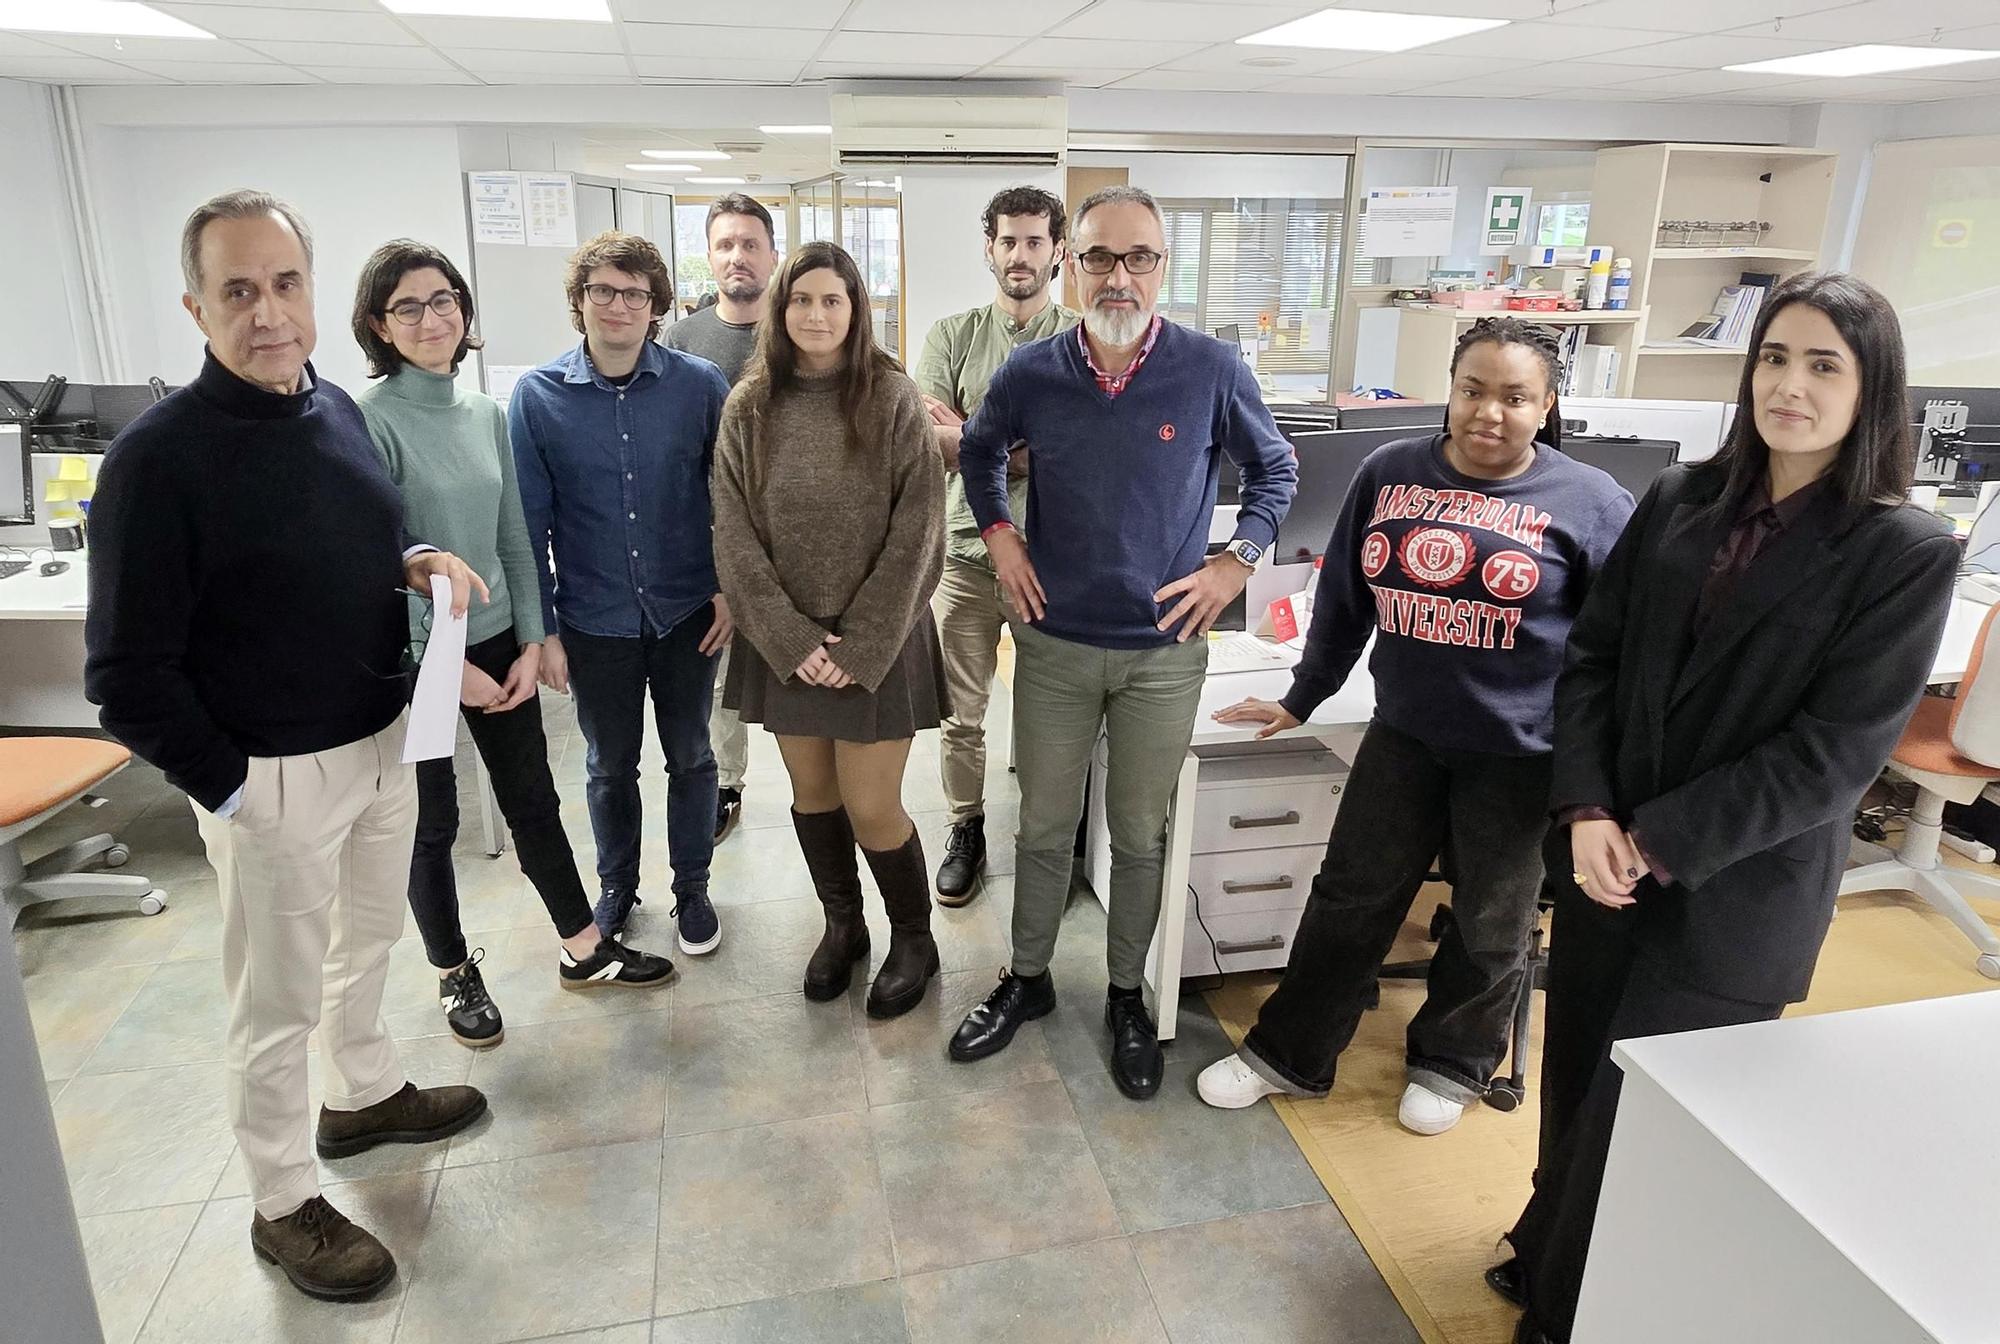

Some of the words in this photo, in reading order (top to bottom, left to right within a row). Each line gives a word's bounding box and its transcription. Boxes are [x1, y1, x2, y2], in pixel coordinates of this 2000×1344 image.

[1368, 484, 1552, 554] AMSTERDAM
[1410, 560, 1456, 580] UNIVERSITY
[1489, 558, 1533, 592] 75
